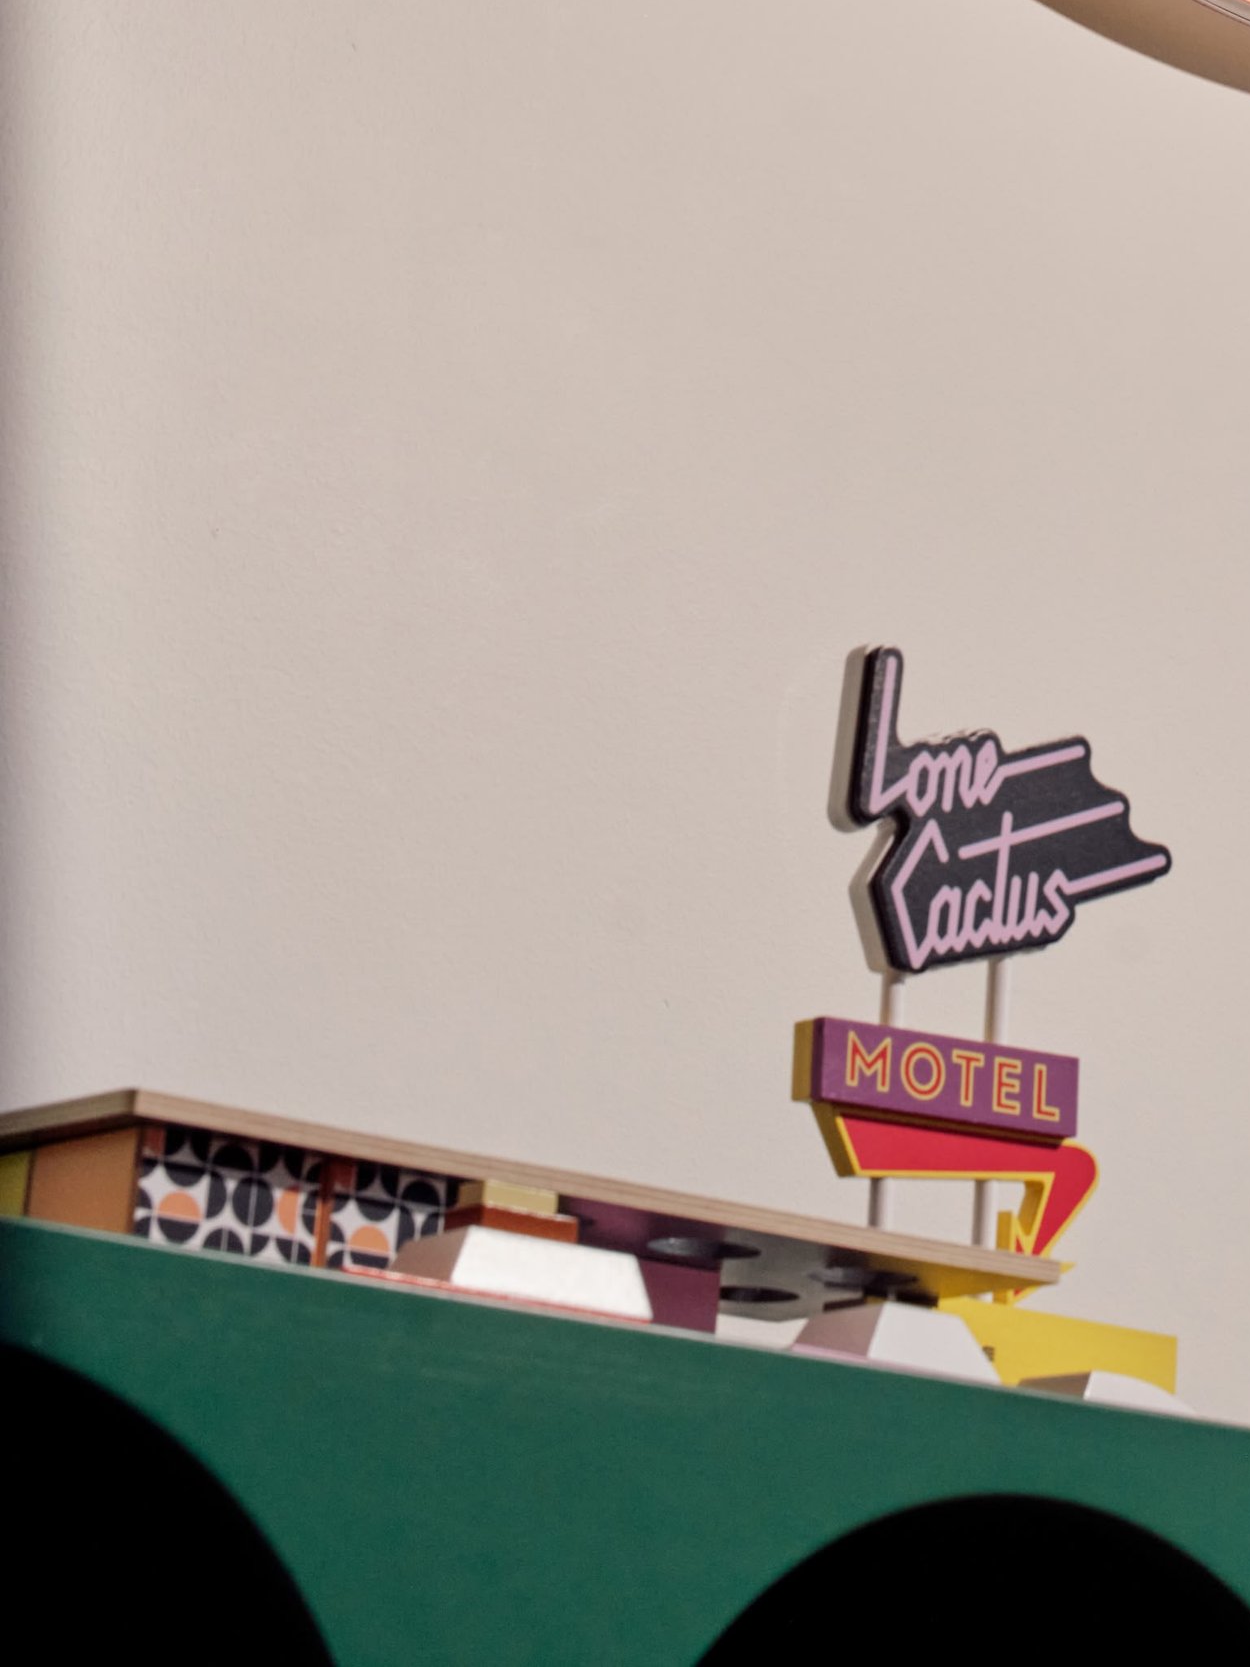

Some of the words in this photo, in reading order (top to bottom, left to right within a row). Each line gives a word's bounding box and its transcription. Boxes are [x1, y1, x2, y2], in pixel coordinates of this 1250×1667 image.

[869, 655, 1086, 816] Lone
[892, 801, 1169, 969] Cactus
[845, 1030, 1060, 1123] MOTEL
